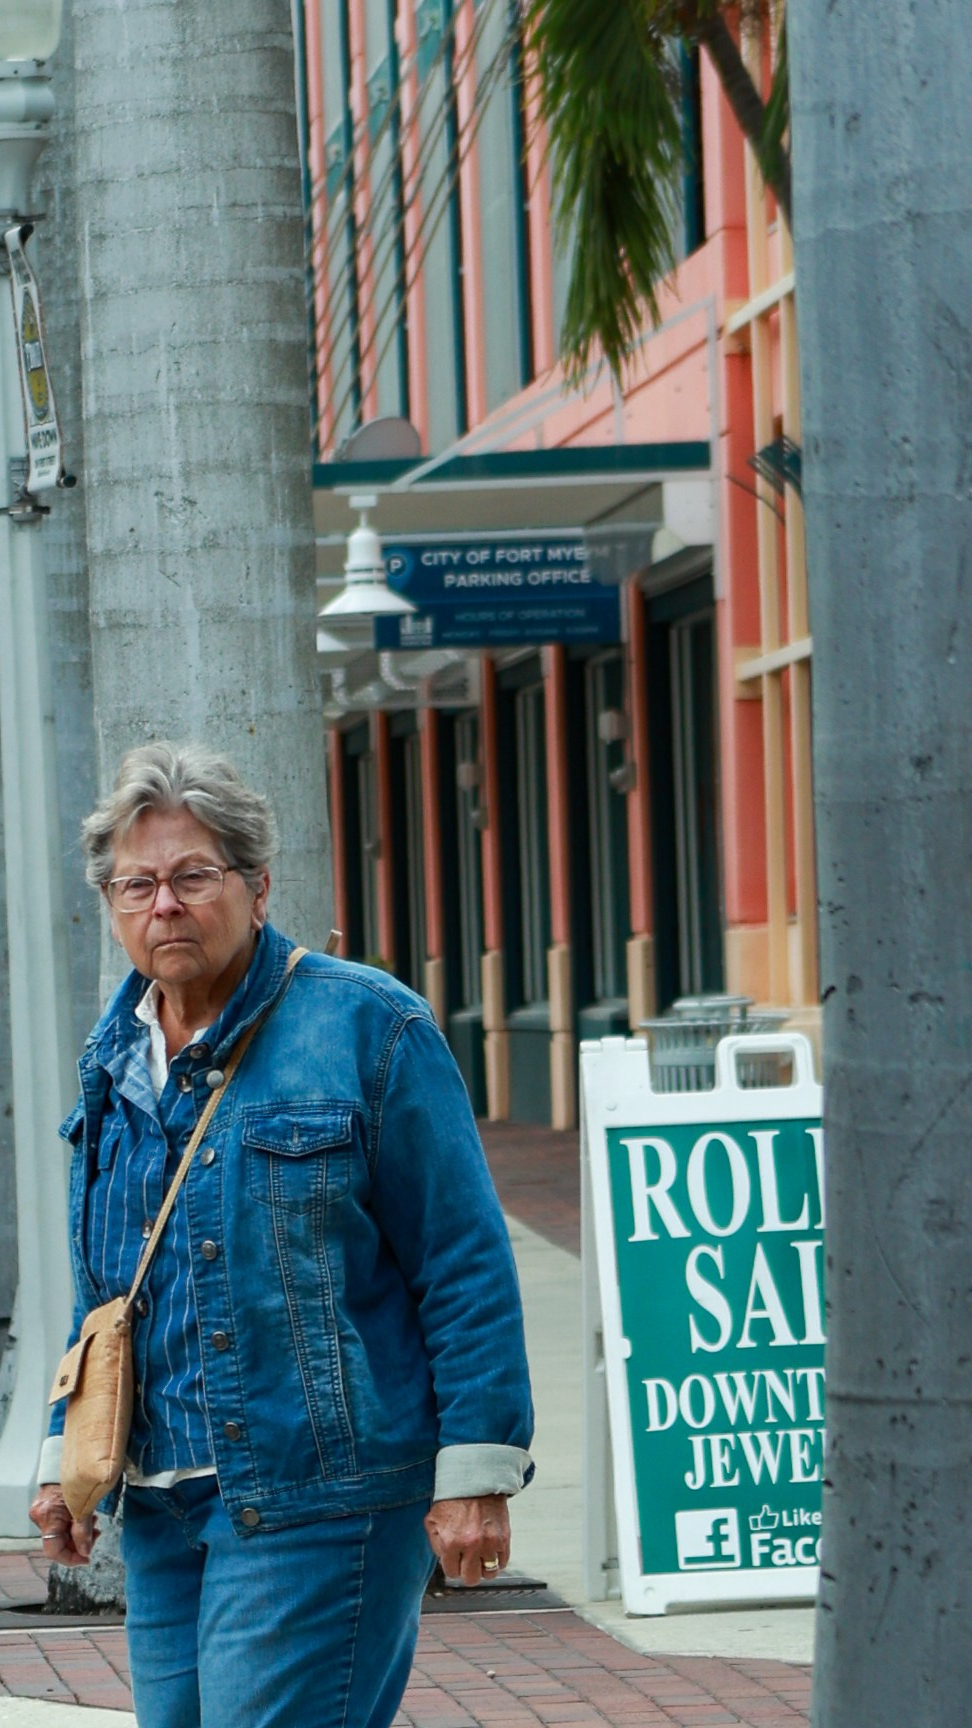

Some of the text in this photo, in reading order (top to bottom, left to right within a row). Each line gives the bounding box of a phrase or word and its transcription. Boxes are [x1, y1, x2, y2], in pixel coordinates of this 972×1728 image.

[421, 547, 590, 566] CITY OF FORT MYE
[444, 570, 591, 588] PARKING OFFICE
[642, 1368, 826, 1432] DOWNT
[684, 1428, 826, 1490] JEWE
[782, 1508, 822, 1527] Like
[750, 1532, 821, 1567] Fac
